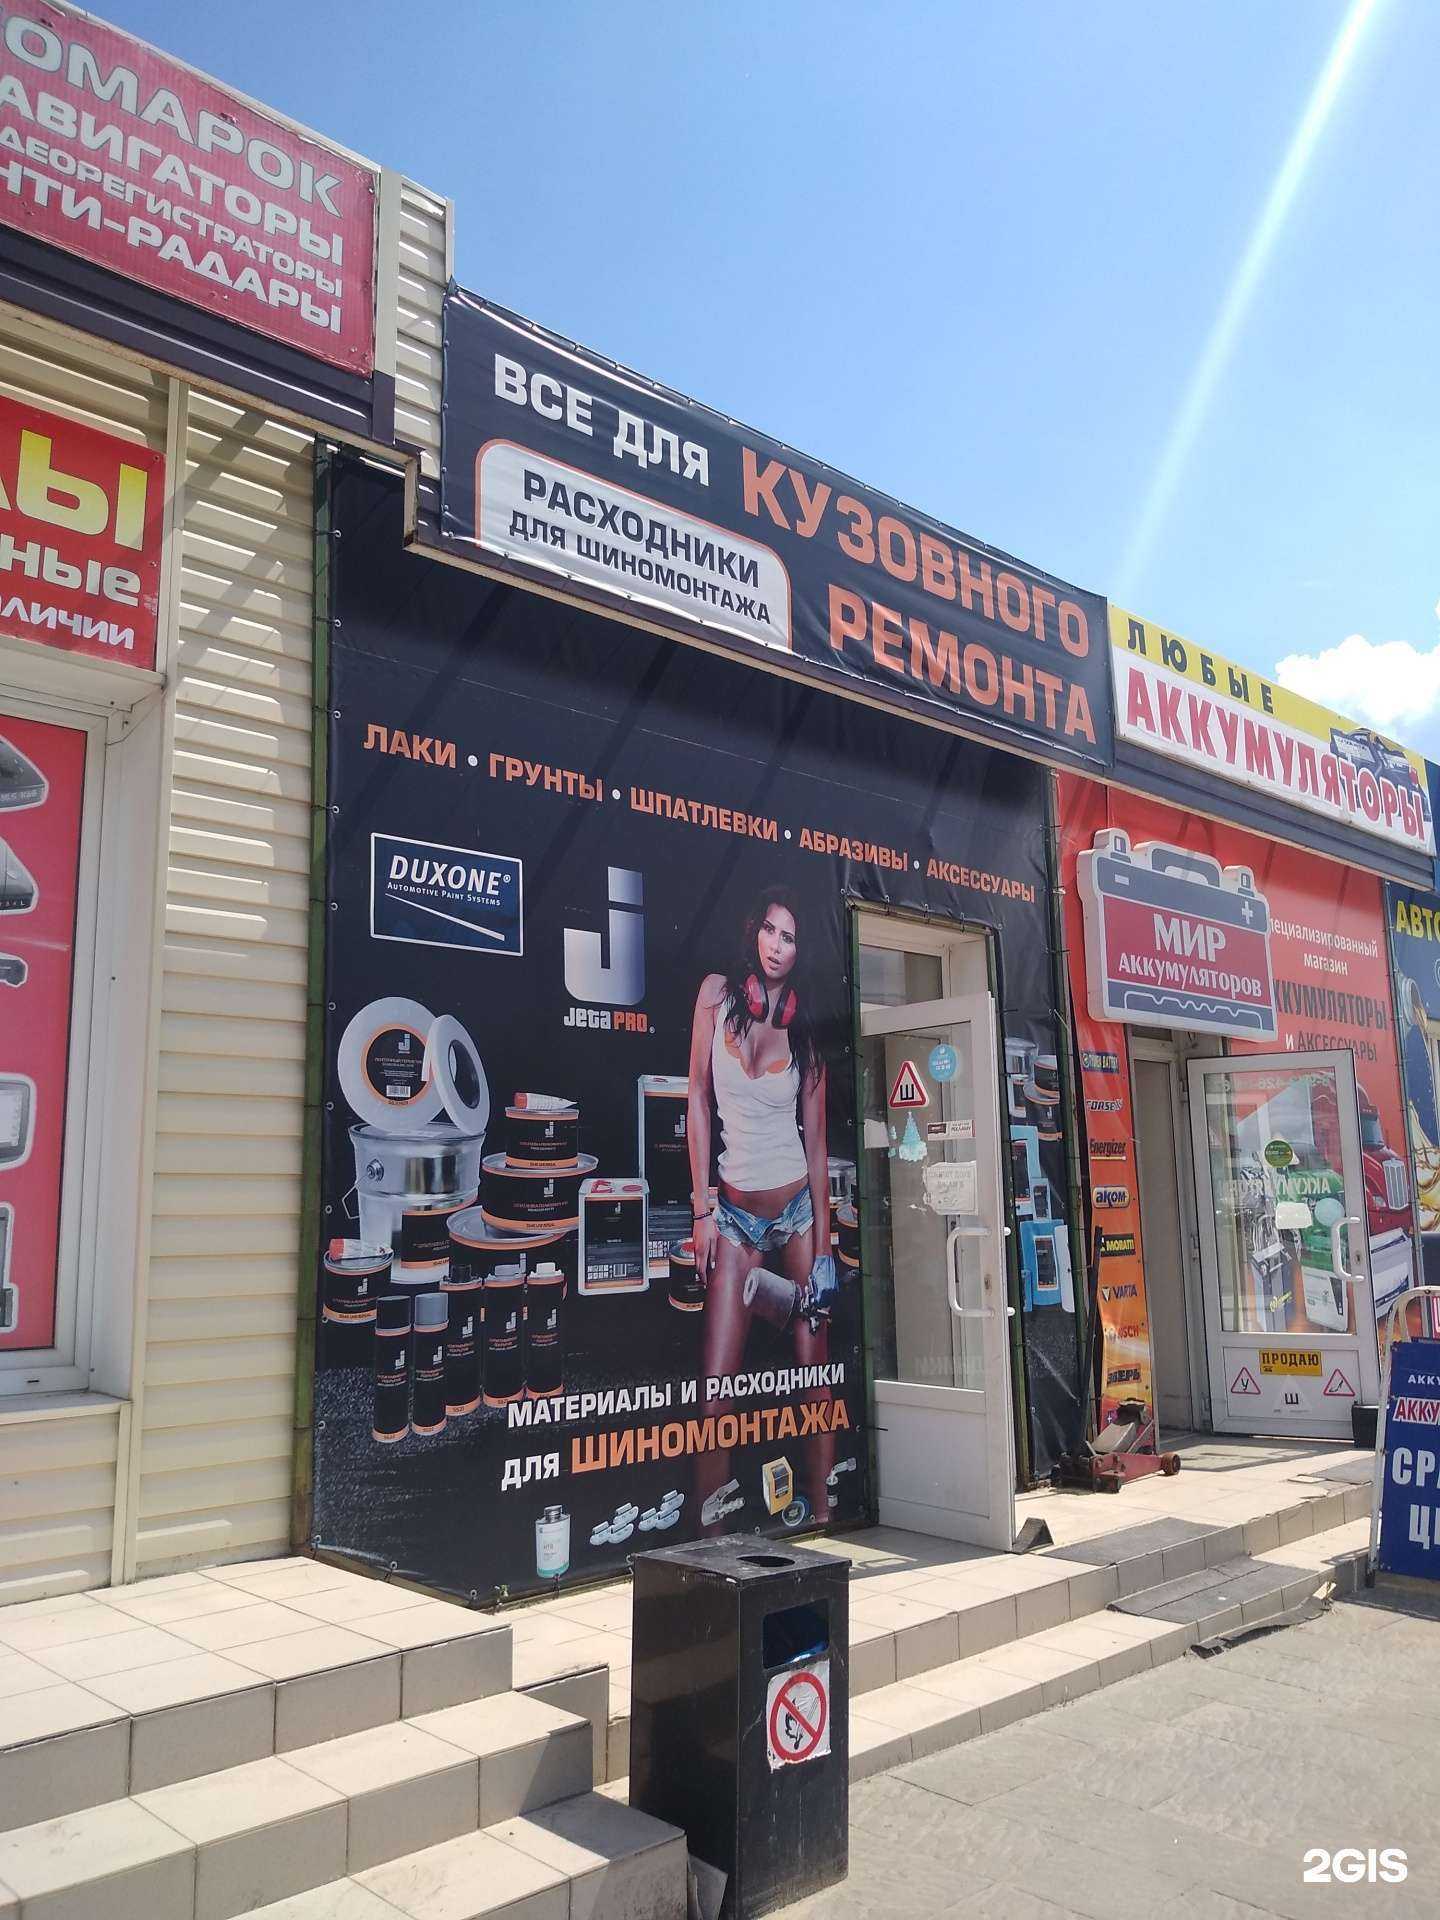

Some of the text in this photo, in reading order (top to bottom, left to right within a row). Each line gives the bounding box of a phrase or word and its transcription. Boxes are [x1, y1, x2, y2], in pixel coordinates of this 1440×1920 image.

[4, 15, 342, 217] ОМАРОК
[0, 75, 343, 266] АВИГАТОРЫ
[495, 353, 1089, 658] ВСЕ ДЛЯ КУЗОВНОГО
[524, 469, 759, 588] РАСХОДНИКИ
[509, 510, 771, 624] ДЛЯ ШИНОМОНТАЖА
[829, 584, 1096, 744] РЕМОНТА
[1127, 617, 1274, 714] ЛЮБЫЕ
[1126, 666, 1426, 842] АККУМУЛЯТОРЫ
[363, 724, 1035, 904] ЛАКИ ГРУНТЫ ШПАТЛЕВКИ АБРАЗИВЫ АКСЕССУАРЫ
[1118, 952, 1262, 999] Аккумуляторов
[1153, 912, 1226, 963] МИР
[1304, 952, 1349, 976] магазин
[900, 1083, 915, 1101] Ш
[1113, 1284, 1138, 1299] VARTA
[507, 1362, 846, 1429] МАТЕРИАЛЫ И РАСХОДНИКИ
[1262, 1352, 1320, 1367] ПРОДАЮ
[1285, 1393, 1299, 1405] Ш
[501, 1399, 850, 1492] ДЛЯ ШИНОМОНТАЖА
[1392, 1447, 1440, 1486] СР
